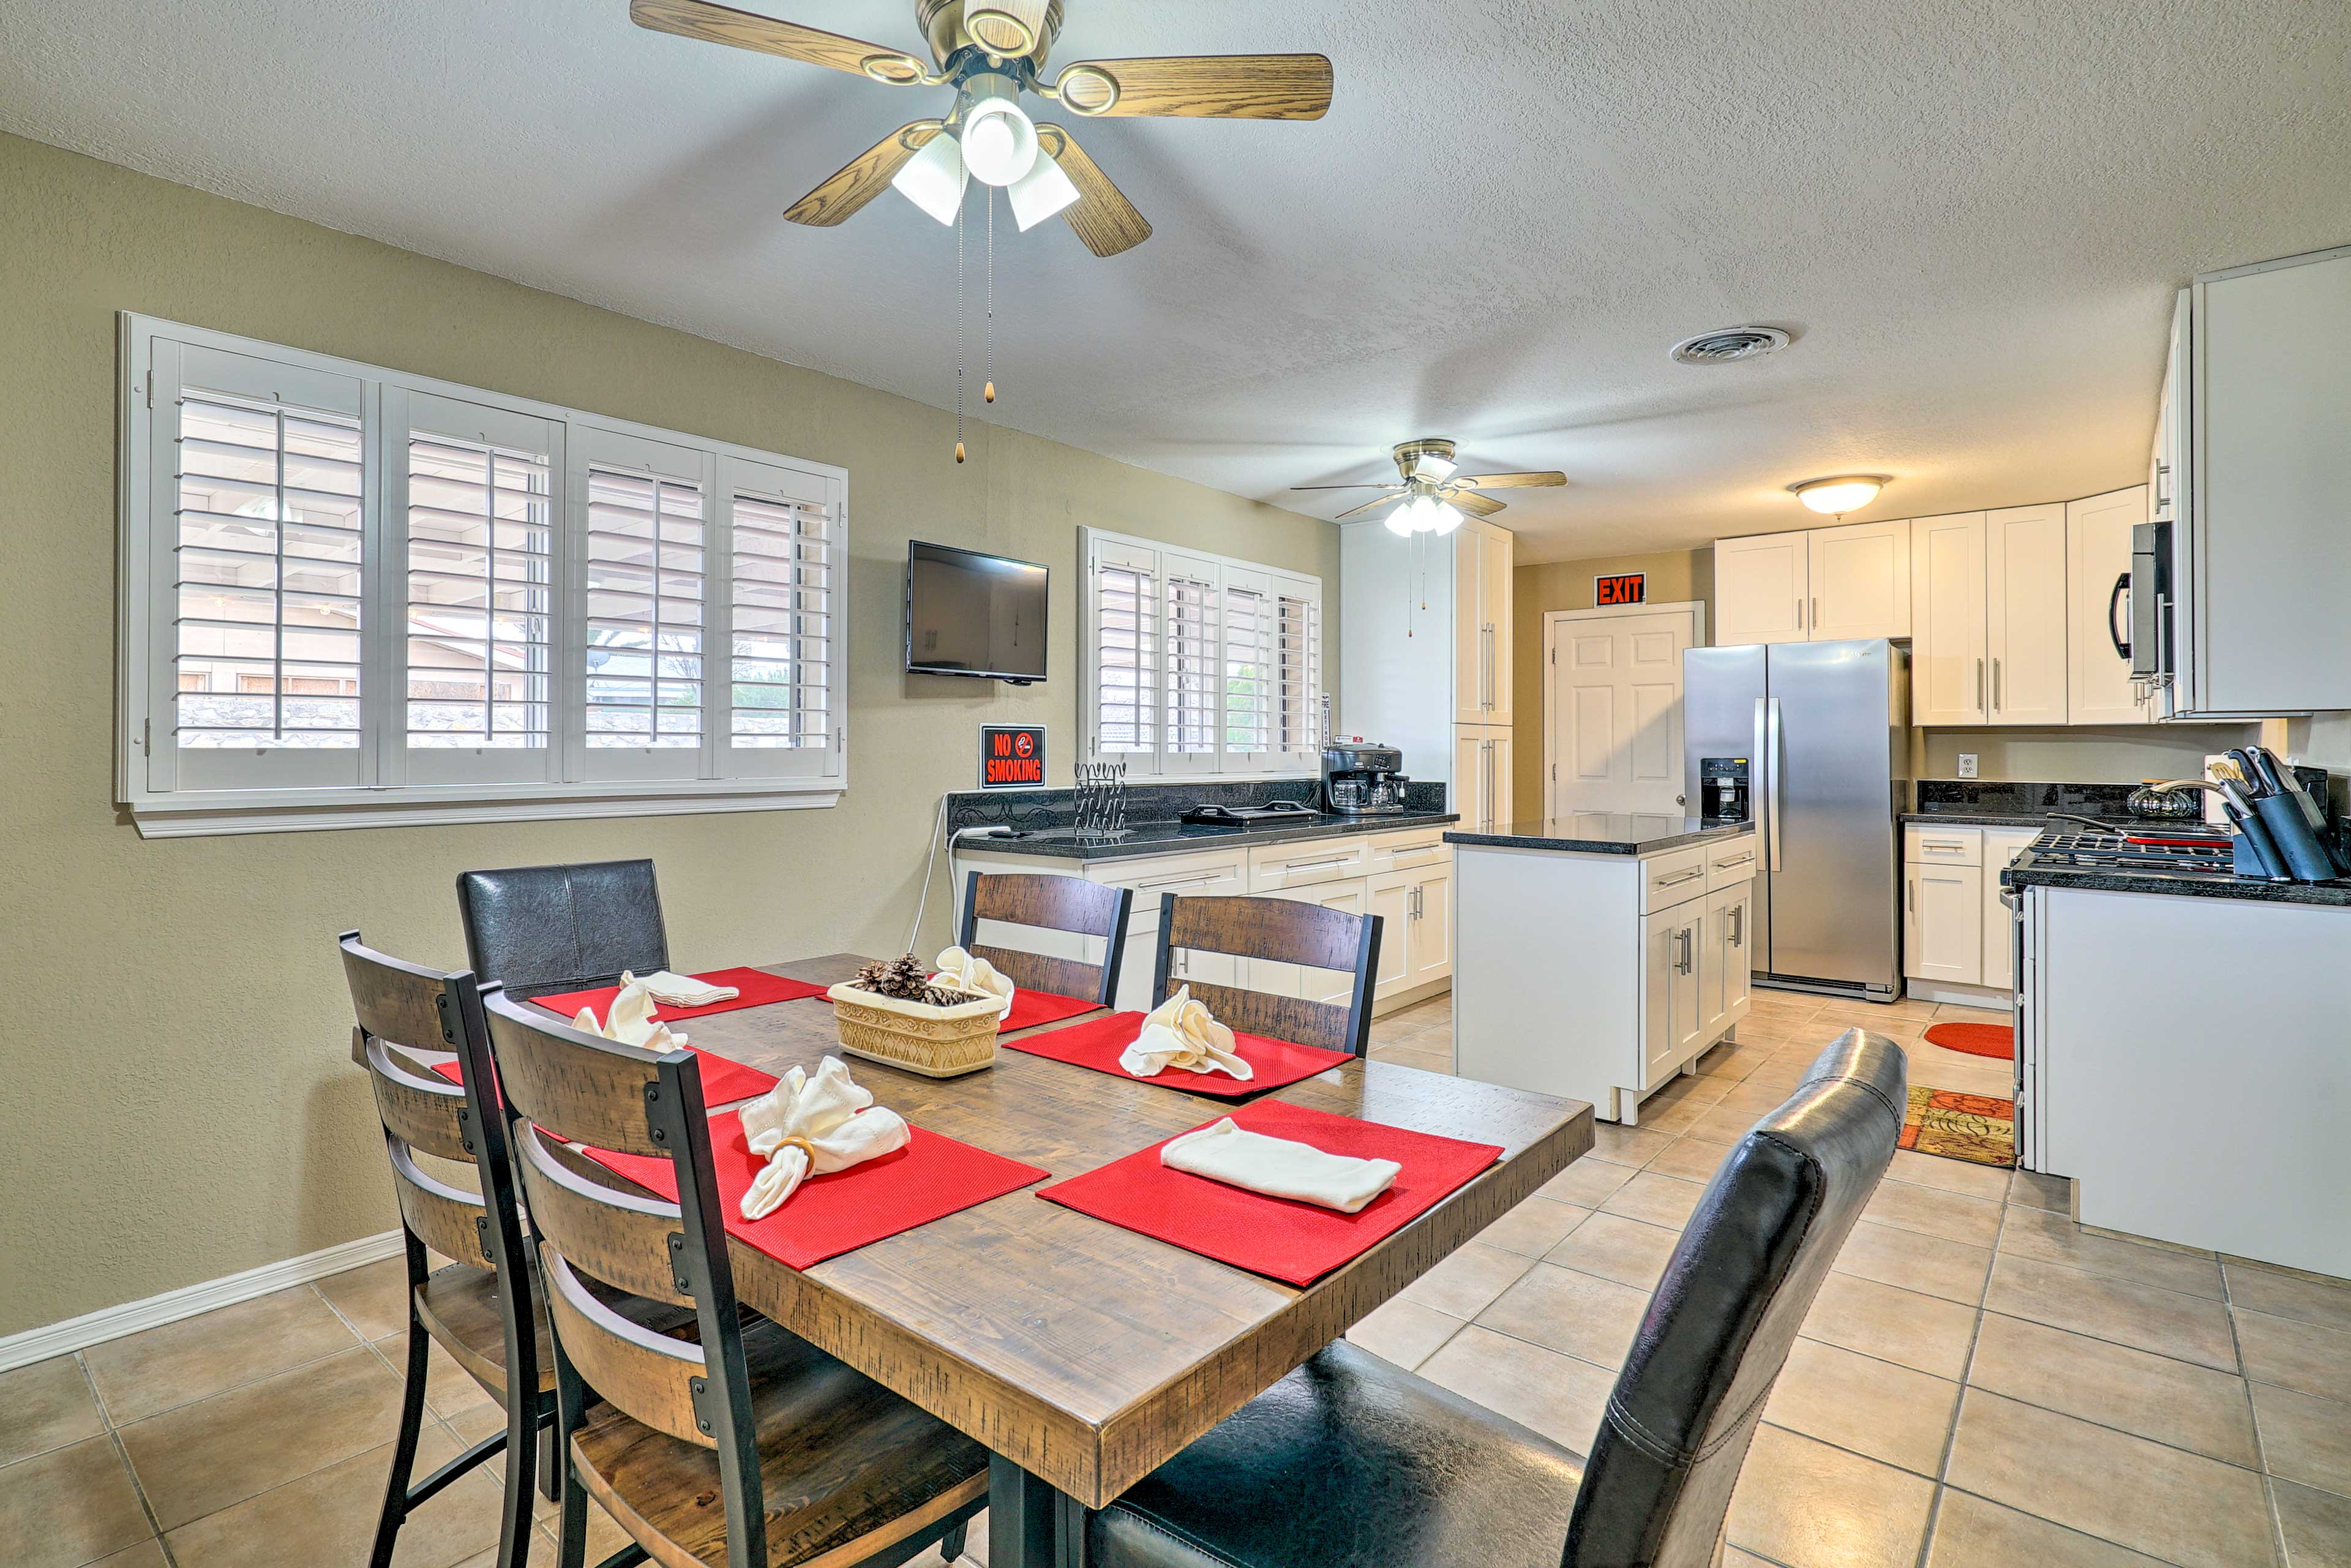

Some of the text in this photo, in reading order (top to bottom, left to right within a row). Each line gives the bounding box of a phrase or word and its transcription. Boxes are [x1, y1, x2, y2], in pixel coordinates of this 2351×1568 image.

[1599, 576, 1643, 604] EXIT
[994, 733, 1011, 757] NO
[987, 759, 1041, 782] SMOKING
